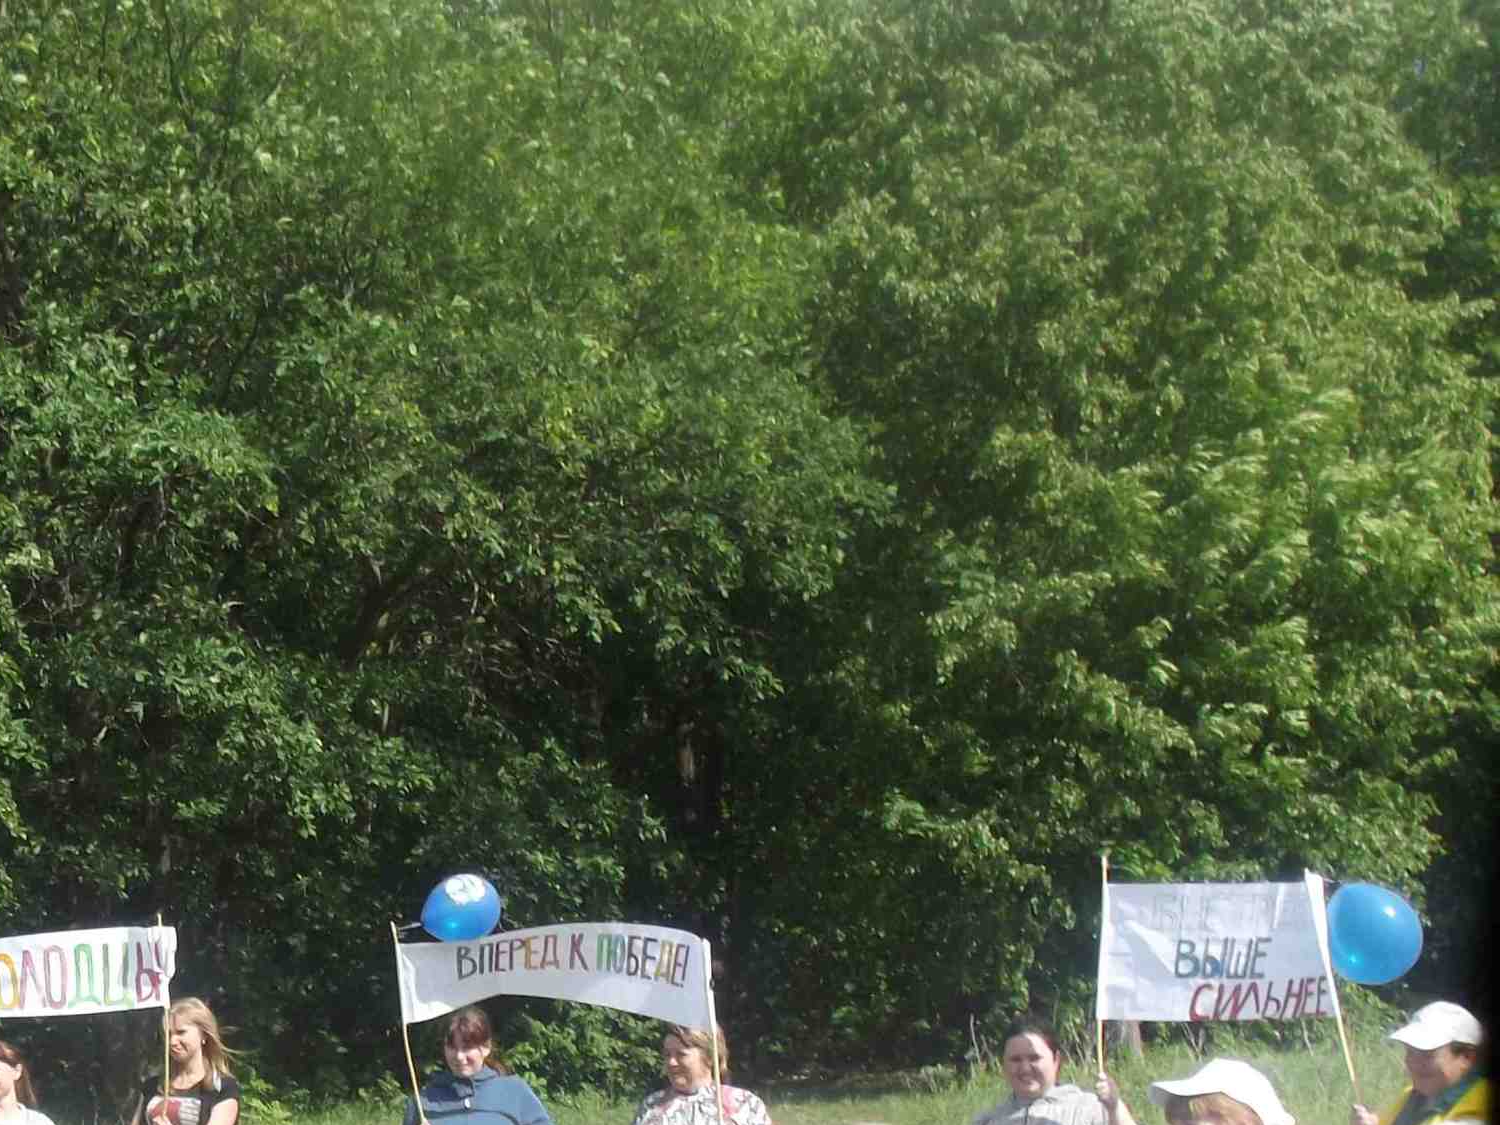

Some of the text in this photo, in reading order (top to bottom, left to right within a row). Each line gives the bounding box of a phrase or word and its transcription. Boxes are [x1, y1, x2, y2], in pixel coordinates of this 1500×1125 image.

[456, 933, 690, 988] ВПЕРЕД К ПОБЕДЕ!
[1175, 937, 1272, 979] ВЫШЕ
[1189, 975, 1329, 1023] СИЛЬНЕЕ
